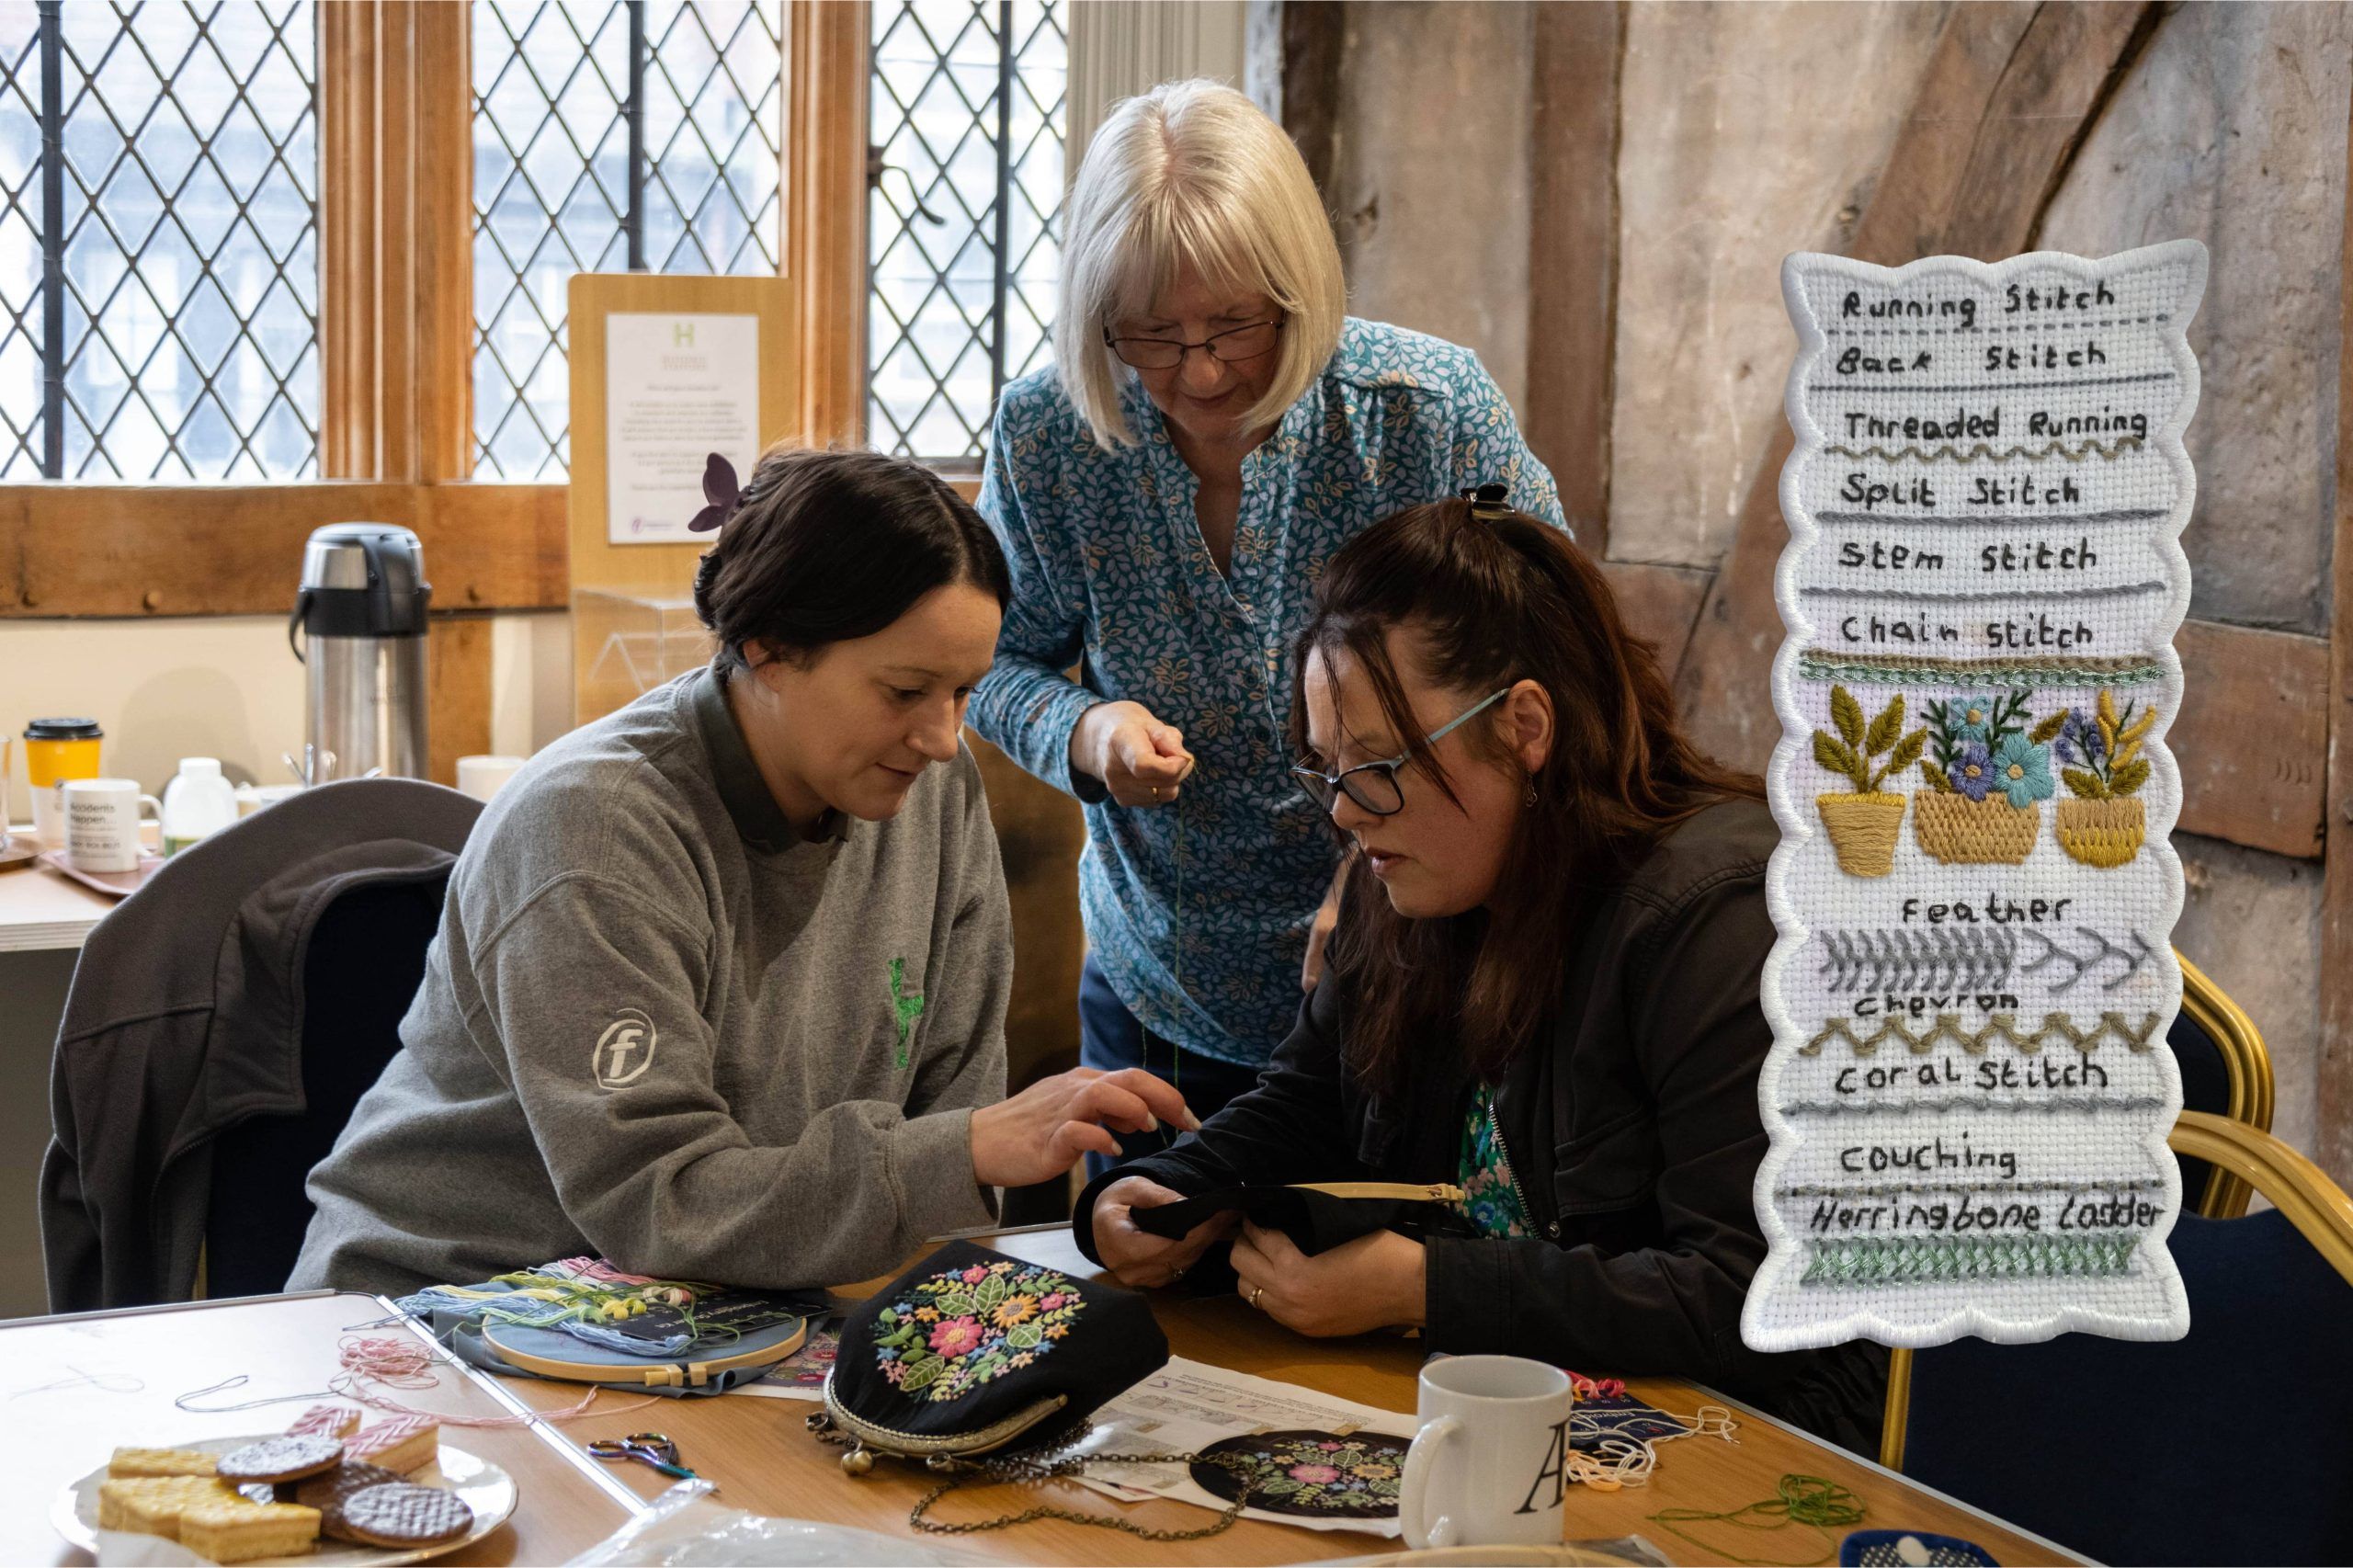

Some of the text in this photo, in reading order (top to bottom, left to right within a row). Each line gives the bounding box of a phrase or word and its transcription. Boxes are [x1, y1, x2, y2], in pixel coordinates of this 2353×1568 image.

[673, 322, 696, 347] H
[608, 1028, 643, 1078] f
[1514, 1418, 1570, 1515] A
